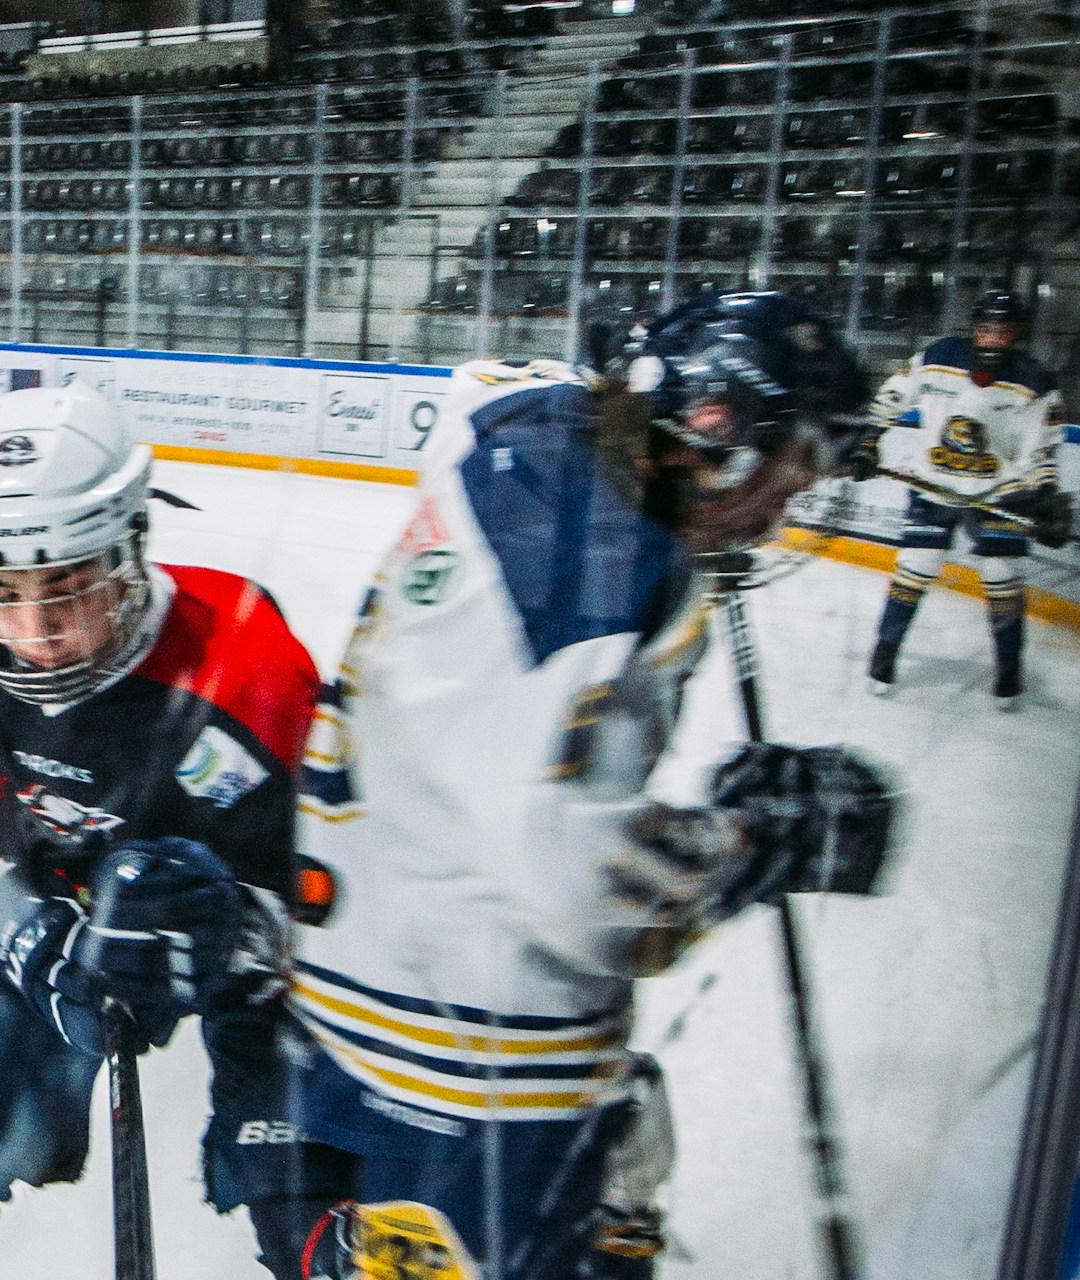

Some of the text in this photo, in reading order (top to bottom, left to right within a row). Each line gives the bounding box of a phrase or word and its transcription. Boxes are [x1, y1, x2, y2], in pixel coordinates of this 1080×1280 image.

[120, 388, 309, 414] RESTAURANT GOURMET
[410, 400, 439, 451] 9
